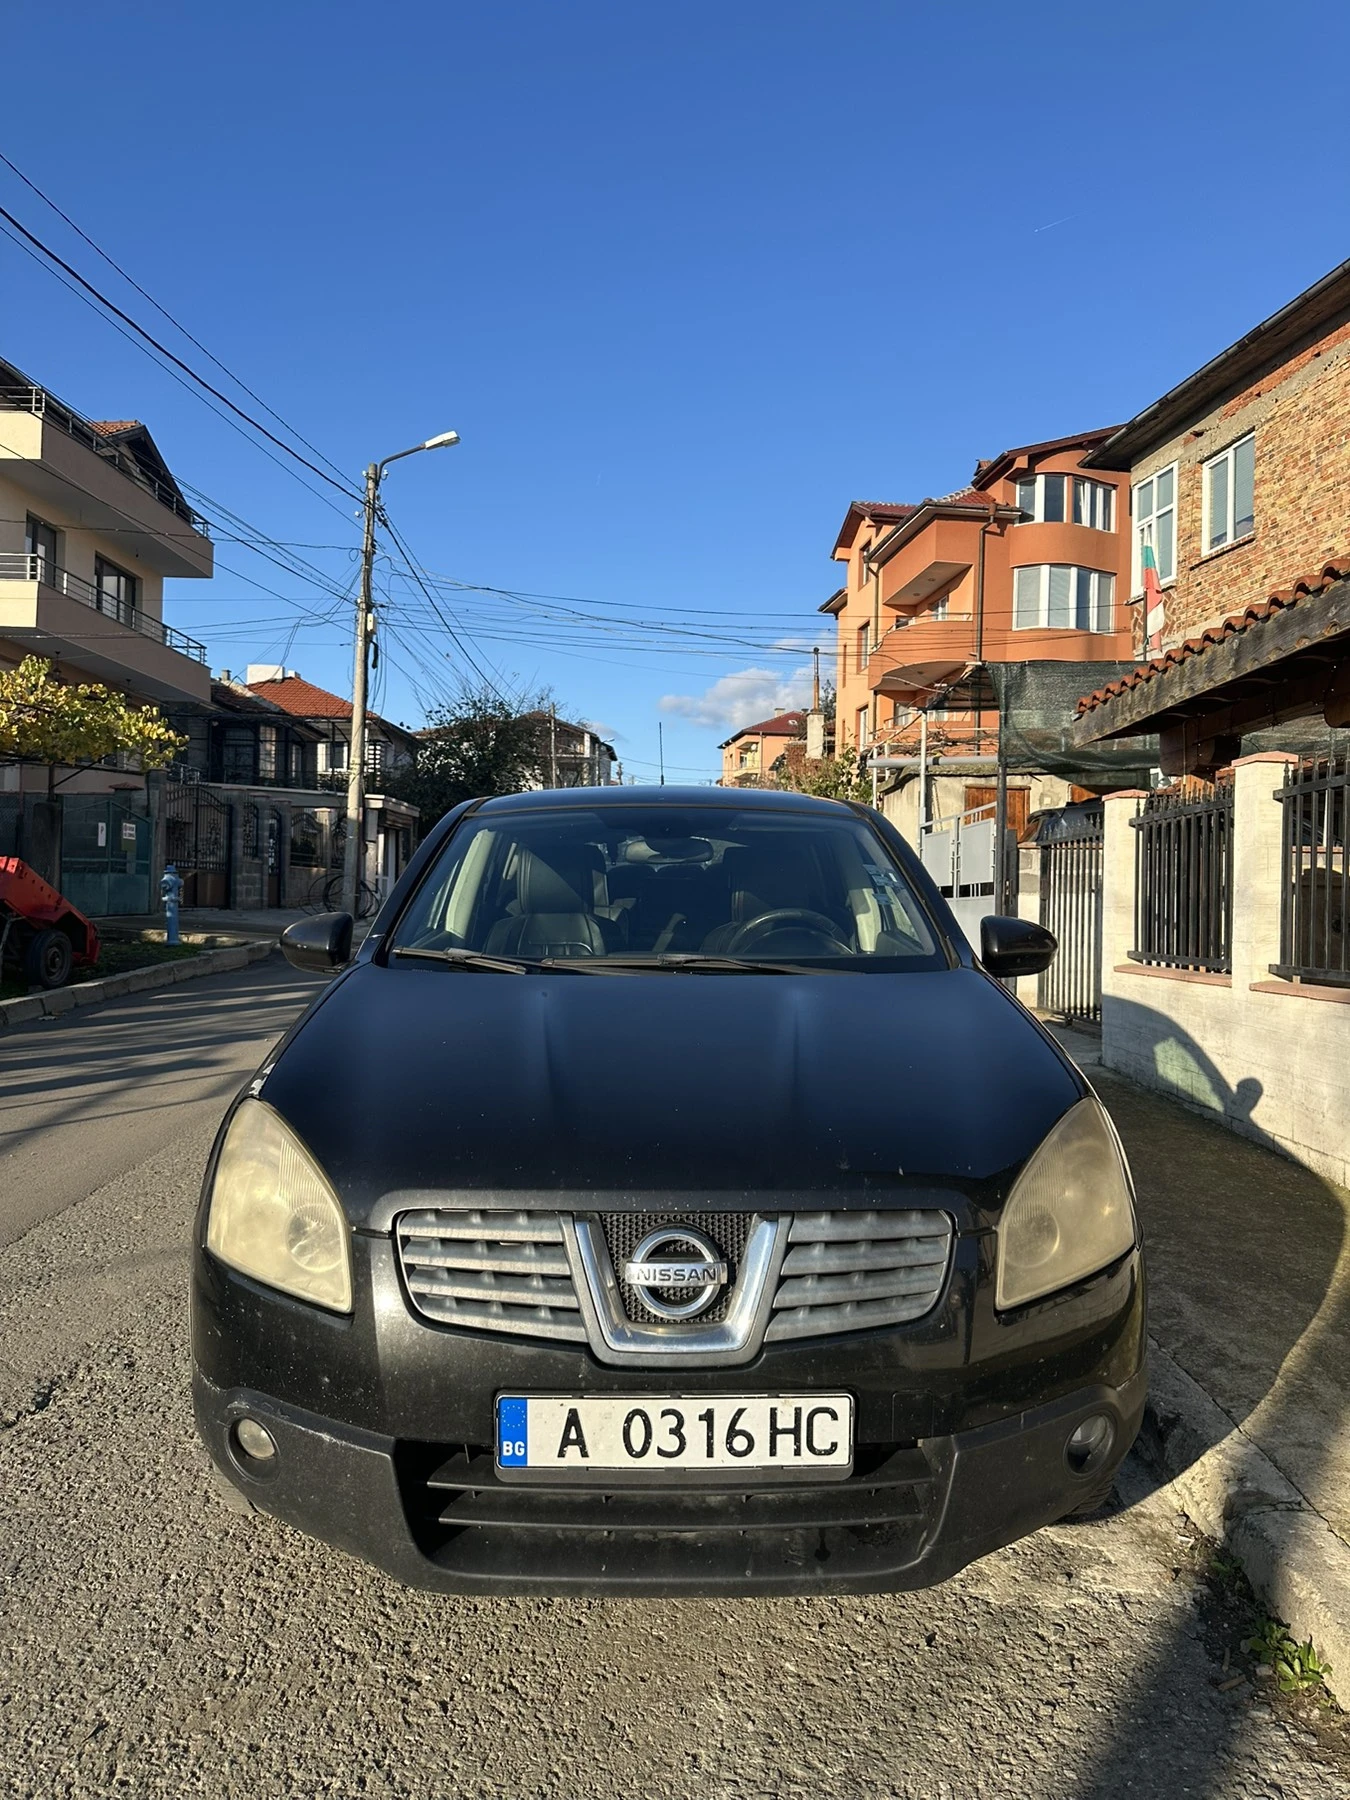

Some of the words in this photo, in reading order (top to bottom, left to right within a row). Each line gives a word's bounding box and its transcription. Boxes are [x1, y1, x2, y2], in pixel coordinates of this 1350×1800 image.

[637, 1267, 717, 1283] NISSAN
[557, 1407, 590, 1458] A
[503, 1440, 525, 1456] BG
